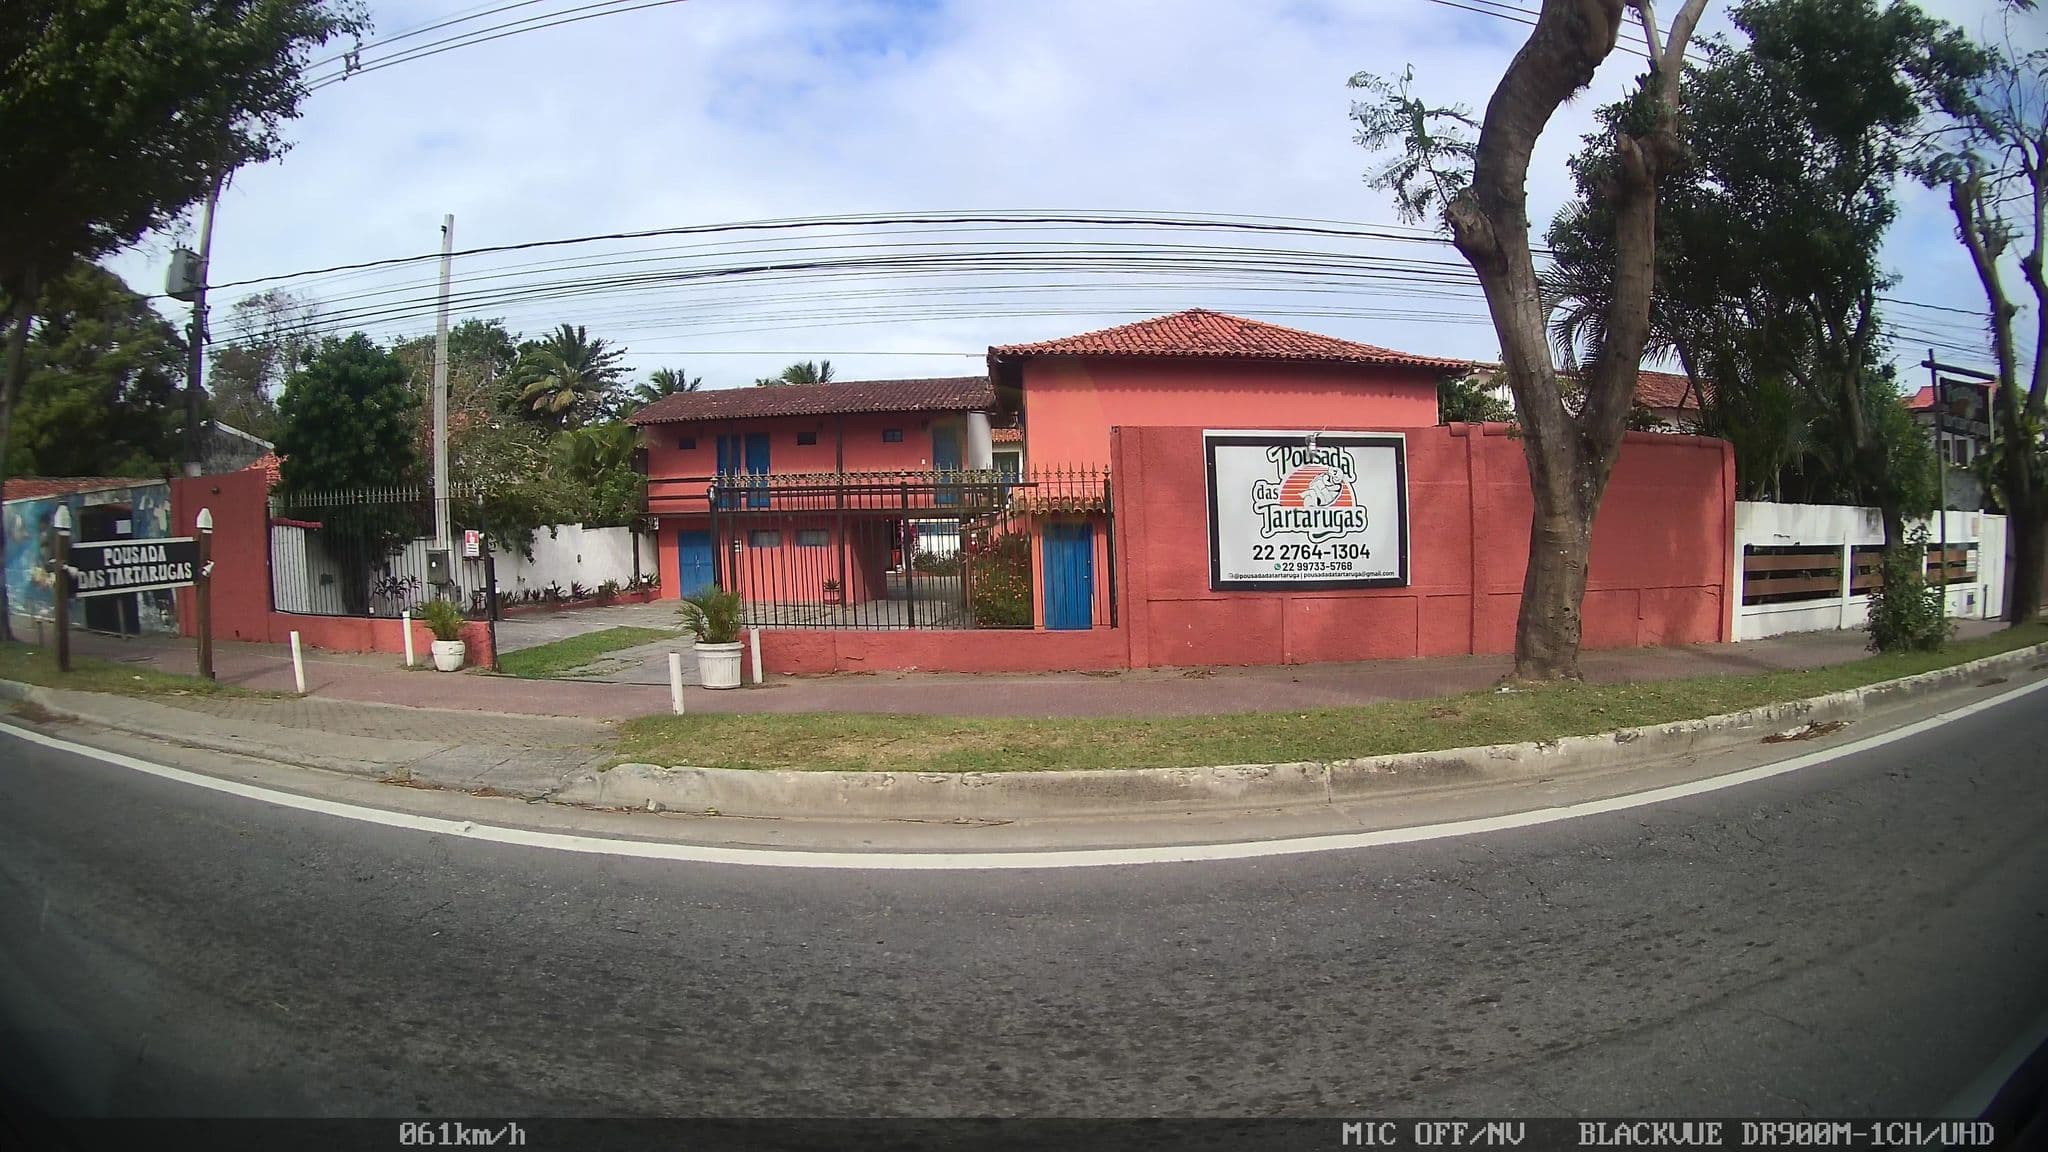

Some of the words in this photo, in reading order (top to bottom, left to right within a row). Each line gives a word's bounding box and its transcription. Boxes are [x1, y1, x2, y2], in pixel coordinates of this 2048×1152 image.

[1270, 446, 1352, 478] Pousada
[1256, 484, 1279, 500] das
[1257, 503, 1364, 539] Tartarugas
[103, 545, 167, 567] POUSADA
[1252, 544, 1275, 561] 22
[1279, 543, 1371, 560] 2764-1304
[78, 569, 106, 589] DAS
[106, 562, 193, 586] TARTARUGAS
[1282, 562, 1295, 572] 22
[1296, 561, 1353, 572] 99733-5768
